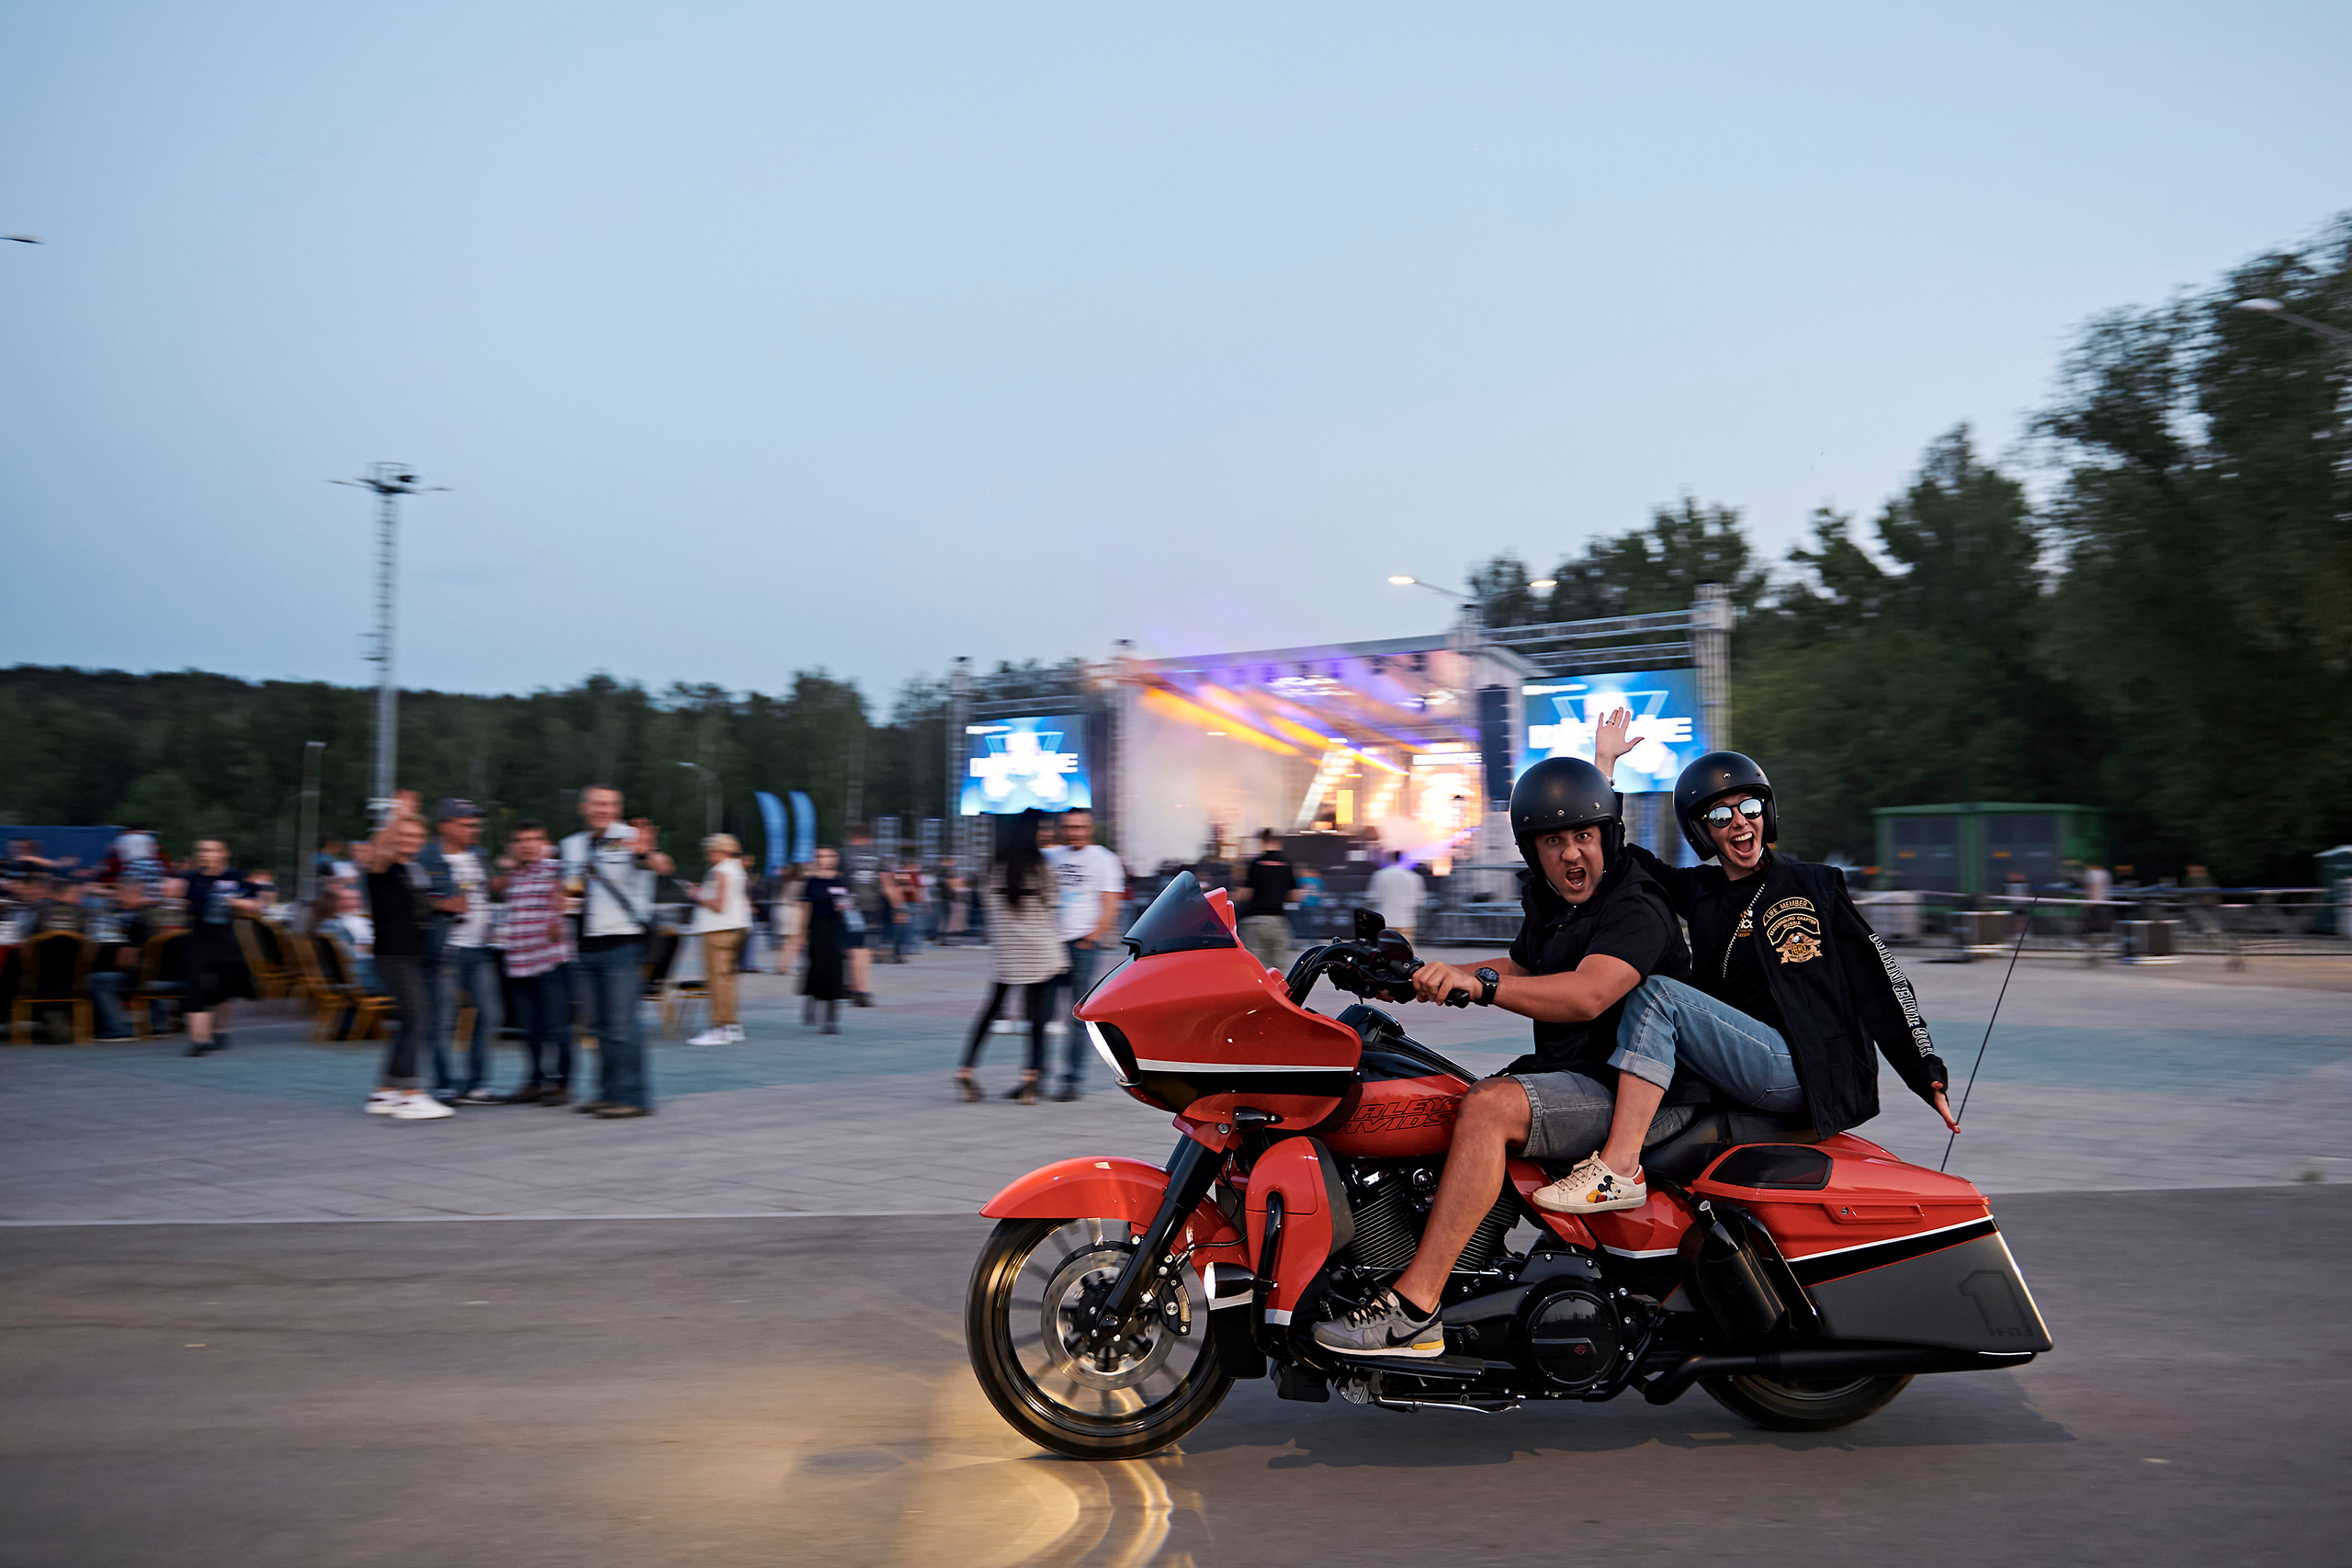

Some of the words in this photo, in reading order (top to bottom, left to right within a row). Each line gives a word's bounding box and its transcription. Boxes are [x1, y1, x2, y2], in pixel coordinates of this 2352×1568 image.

[1765, 908, 1779, 919] LIFE
[1780, 900, 1808, 909] MEMBER
[1352, 1094, 1463, 1121] RLEY-
